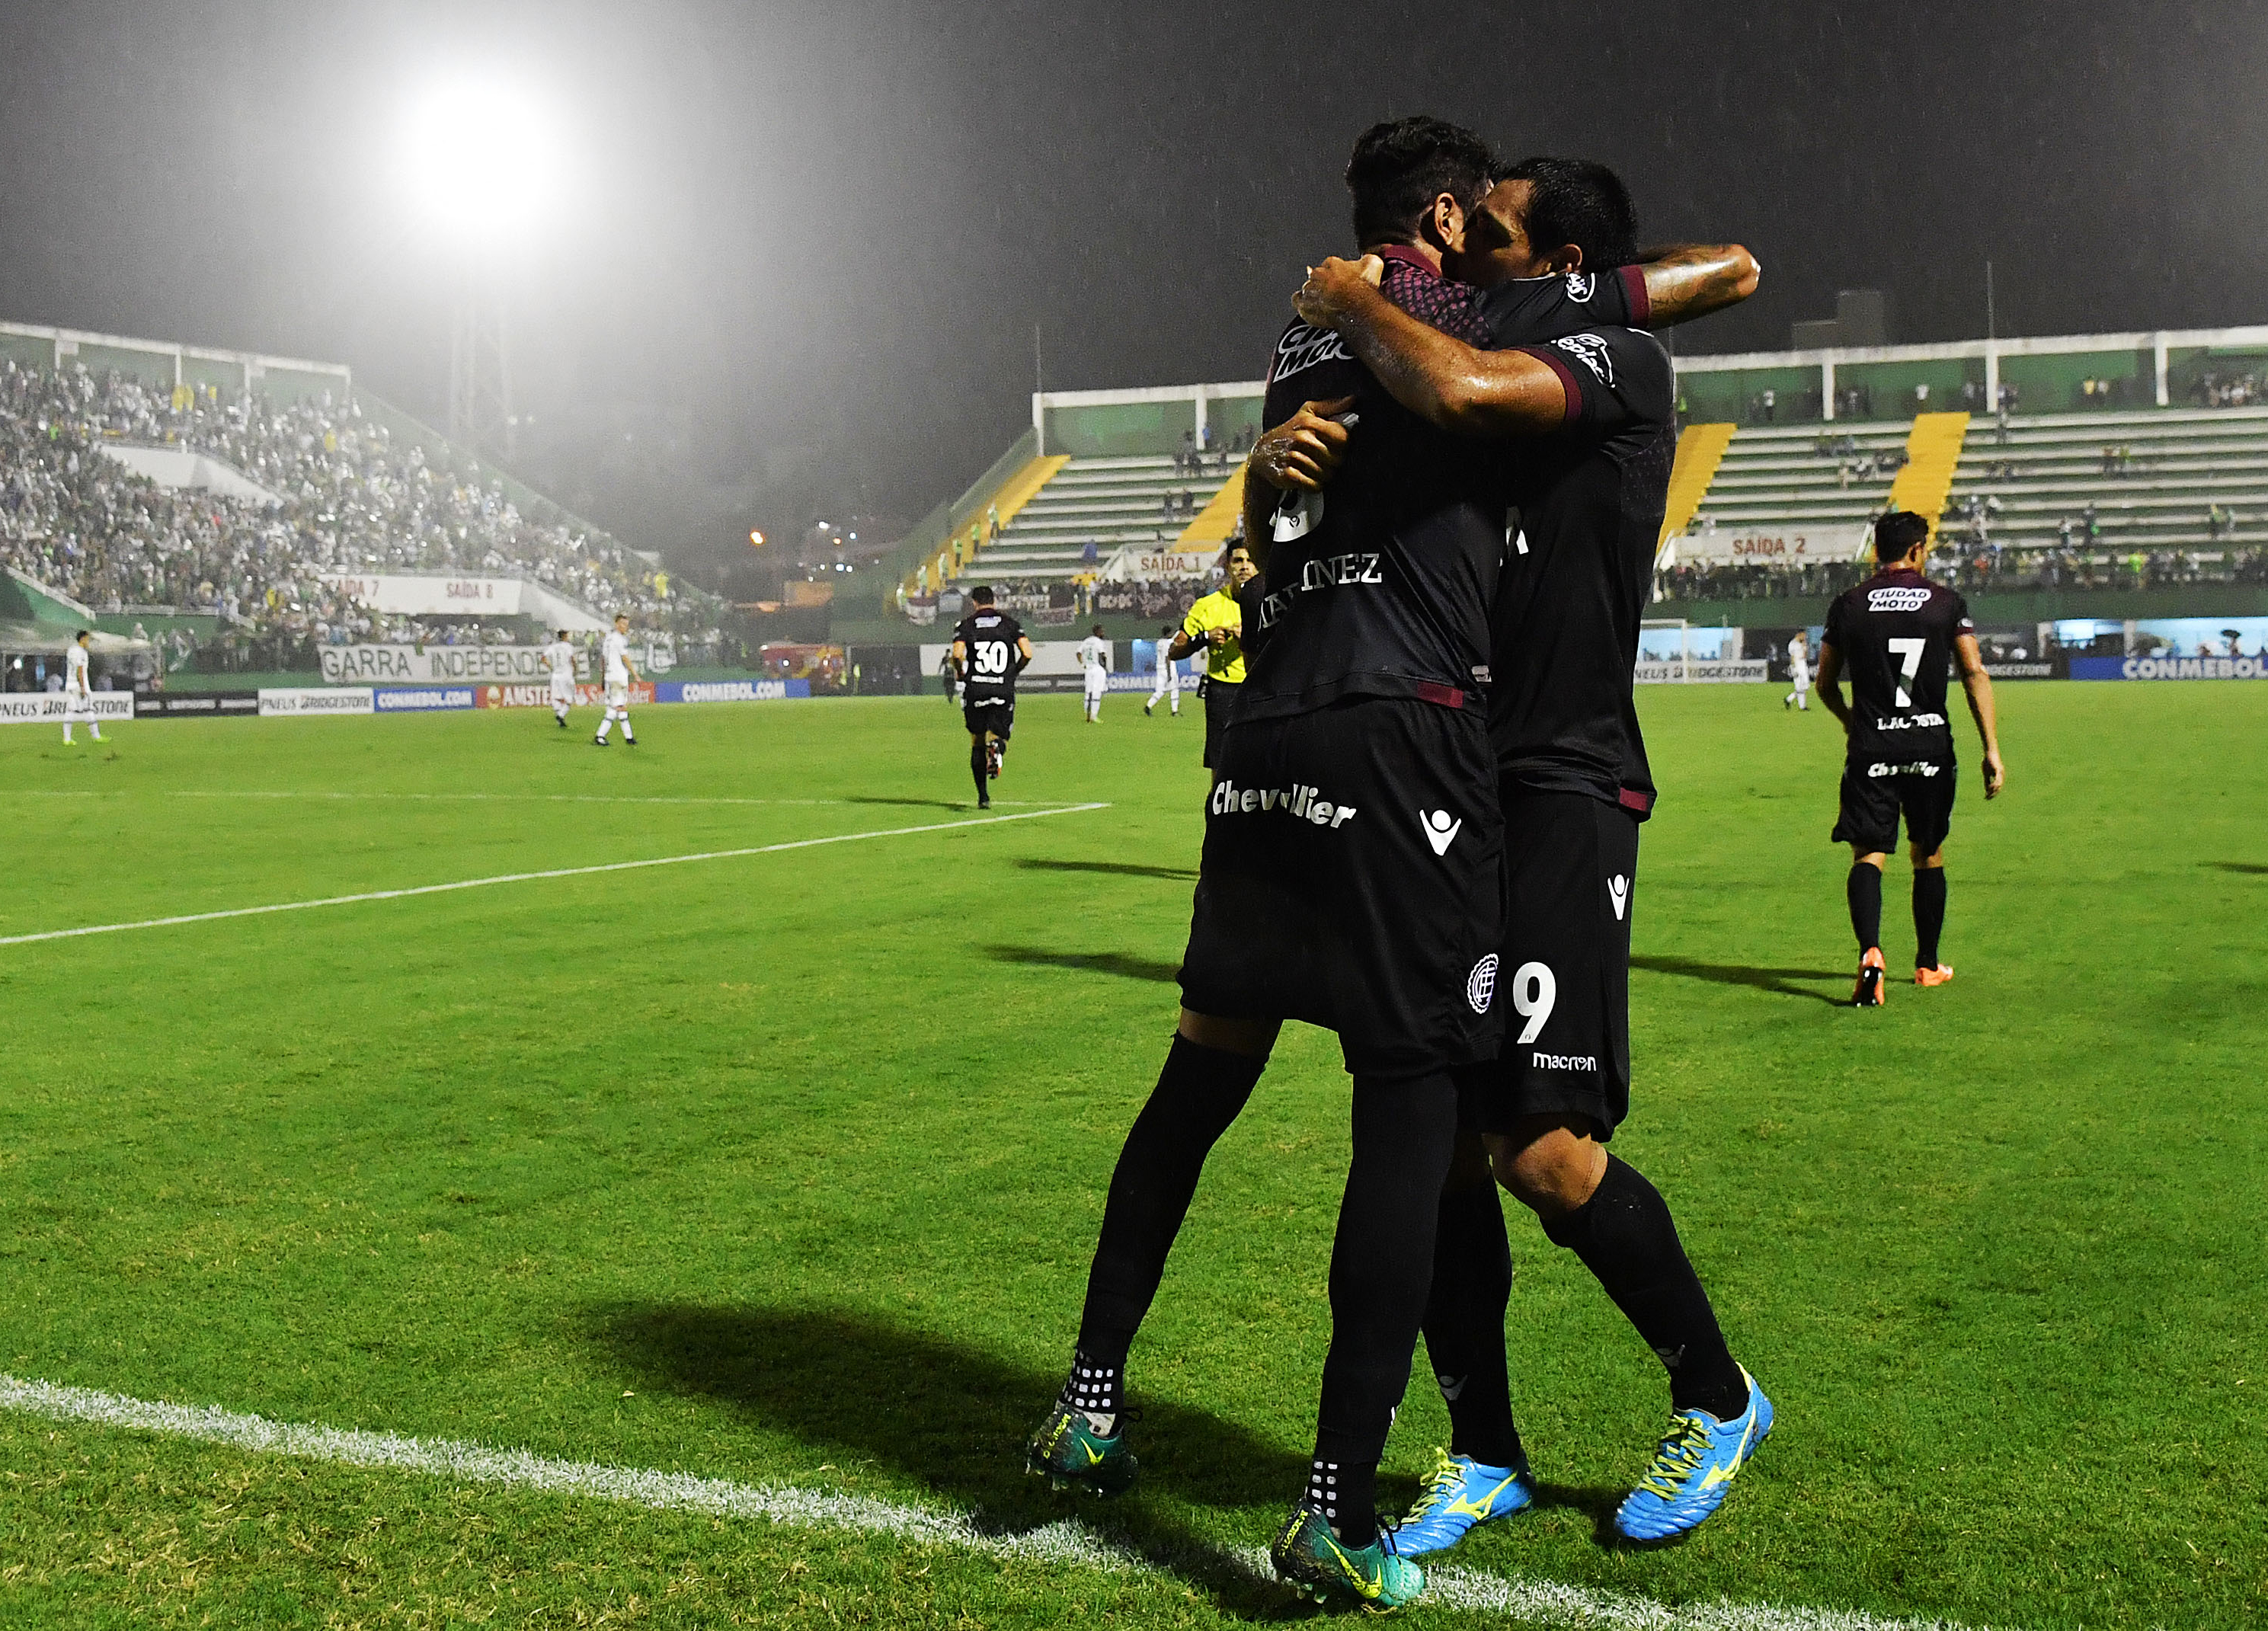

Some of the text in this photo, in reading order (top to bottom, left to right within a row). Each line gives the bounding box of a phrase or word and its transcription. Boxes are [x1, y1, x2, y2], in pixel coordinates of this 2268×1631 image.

[1794, 537, 1806, 554] 2
[1871, 590, 1929, 600] CIUDAD
[1873, 599, 1920, 609] MOTO
[321, 649, 589, 677] GARRA INDEPENDEE
[974, 641, 1009, 674] 30
[1635, 667, 1668, 680] NEUS
[1888, 638, 1926, 708] 7
[2122, 657, 2268, 679] CONMEBOL
[503, 686, 552, 707] AMSTE
[43, 699, 130, 715] BRISTONE
[1513, 961, 1556, 1044] 9
[1533, 1052, 1597, 1071] macron
